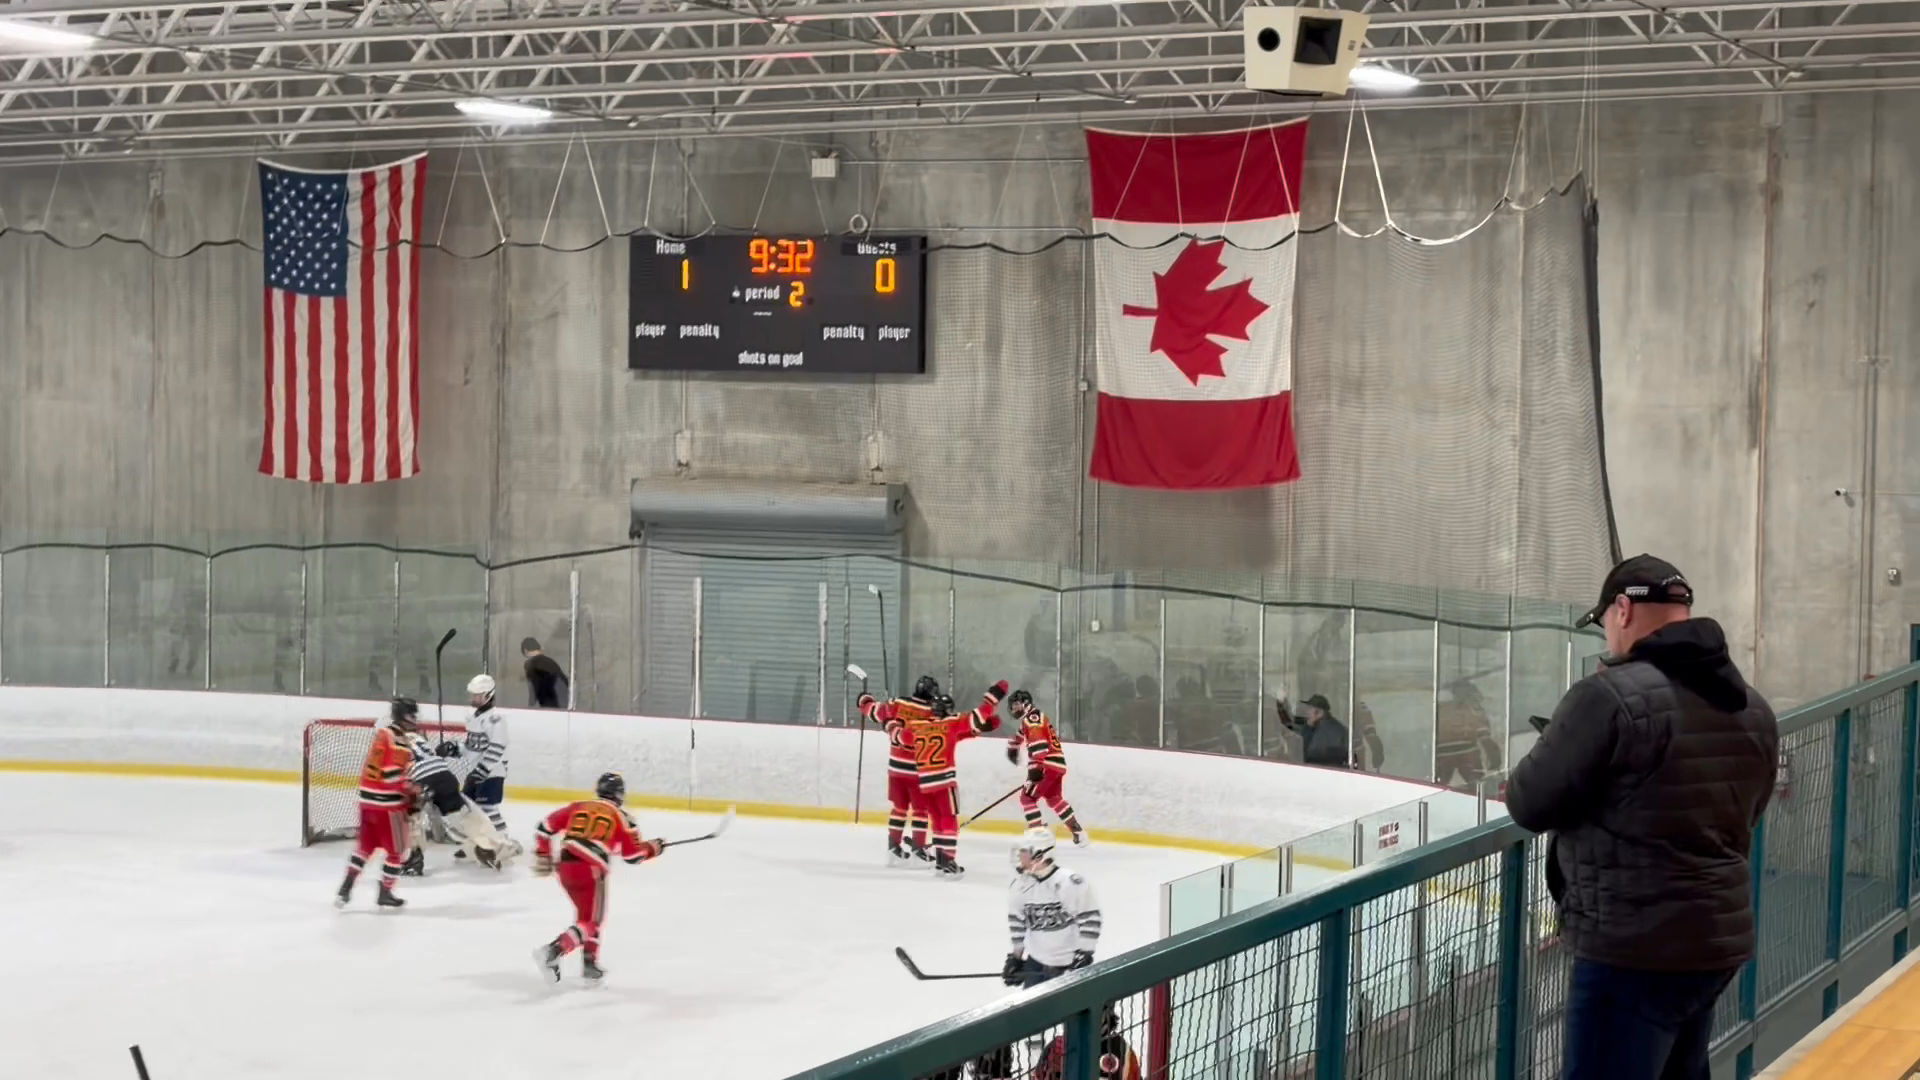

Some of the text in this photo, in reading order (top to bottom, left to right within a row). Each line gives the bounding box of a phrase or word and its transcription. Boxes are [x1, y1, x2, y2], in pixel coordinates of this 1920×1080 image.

[656, 239, 686, 254] Home
[749, 239, 814, 273] 9:32
[682, 259, 689, 290] 1
[875, 258, 895, 292] 0
[745, 281, 804, 307] period 2
[635, 323, 720, 339] player penalty
[823, 325, 911, 341] penalty player
[738, 350, 803, 367] shots on goal
[914, 734, 946, 767] 22
